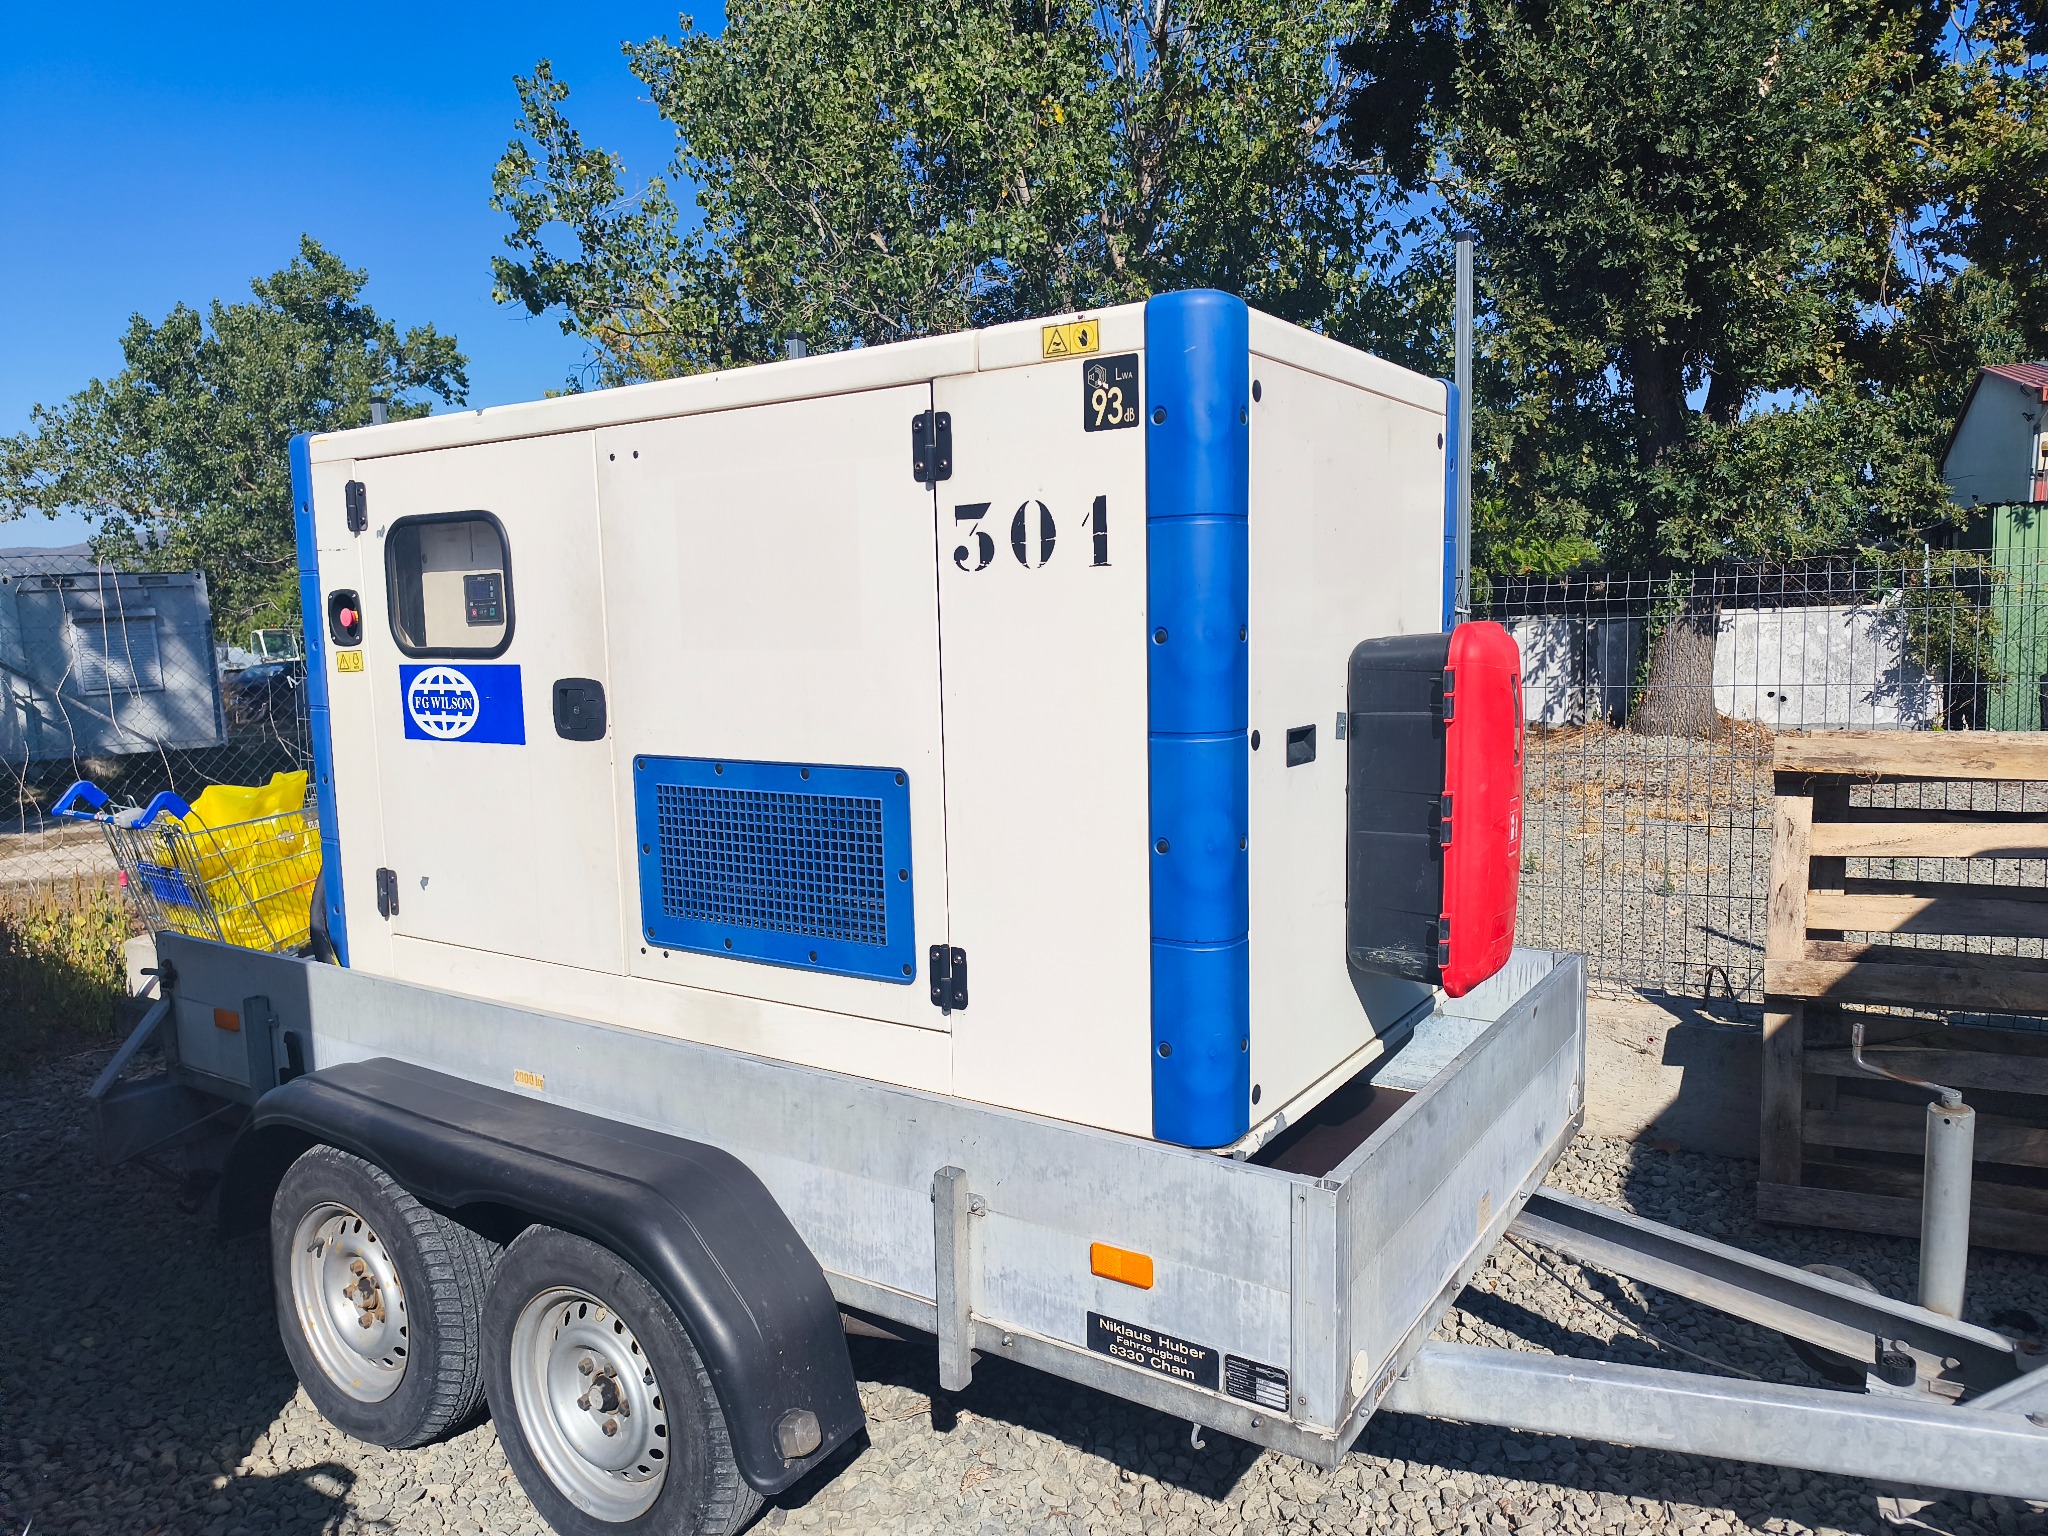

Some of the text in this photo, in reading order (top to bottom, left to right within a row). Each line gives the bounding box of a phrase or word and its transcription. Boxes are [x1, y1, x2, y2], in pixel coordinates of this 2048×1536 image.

[1092, 386, 1135, 426] 93 dB
[953, 494, 1112, 572] 301
[414, 696, 473, 710] FG WILSON
[514, 1070, 534, 1086] 2000
[1099, 1318, 1206, 1360] Niklaus Huber
[1116, 1335, 1188, 1366] Fahrzeugbau
[1109, 1343, 1195, 1380] 6330 Cham
